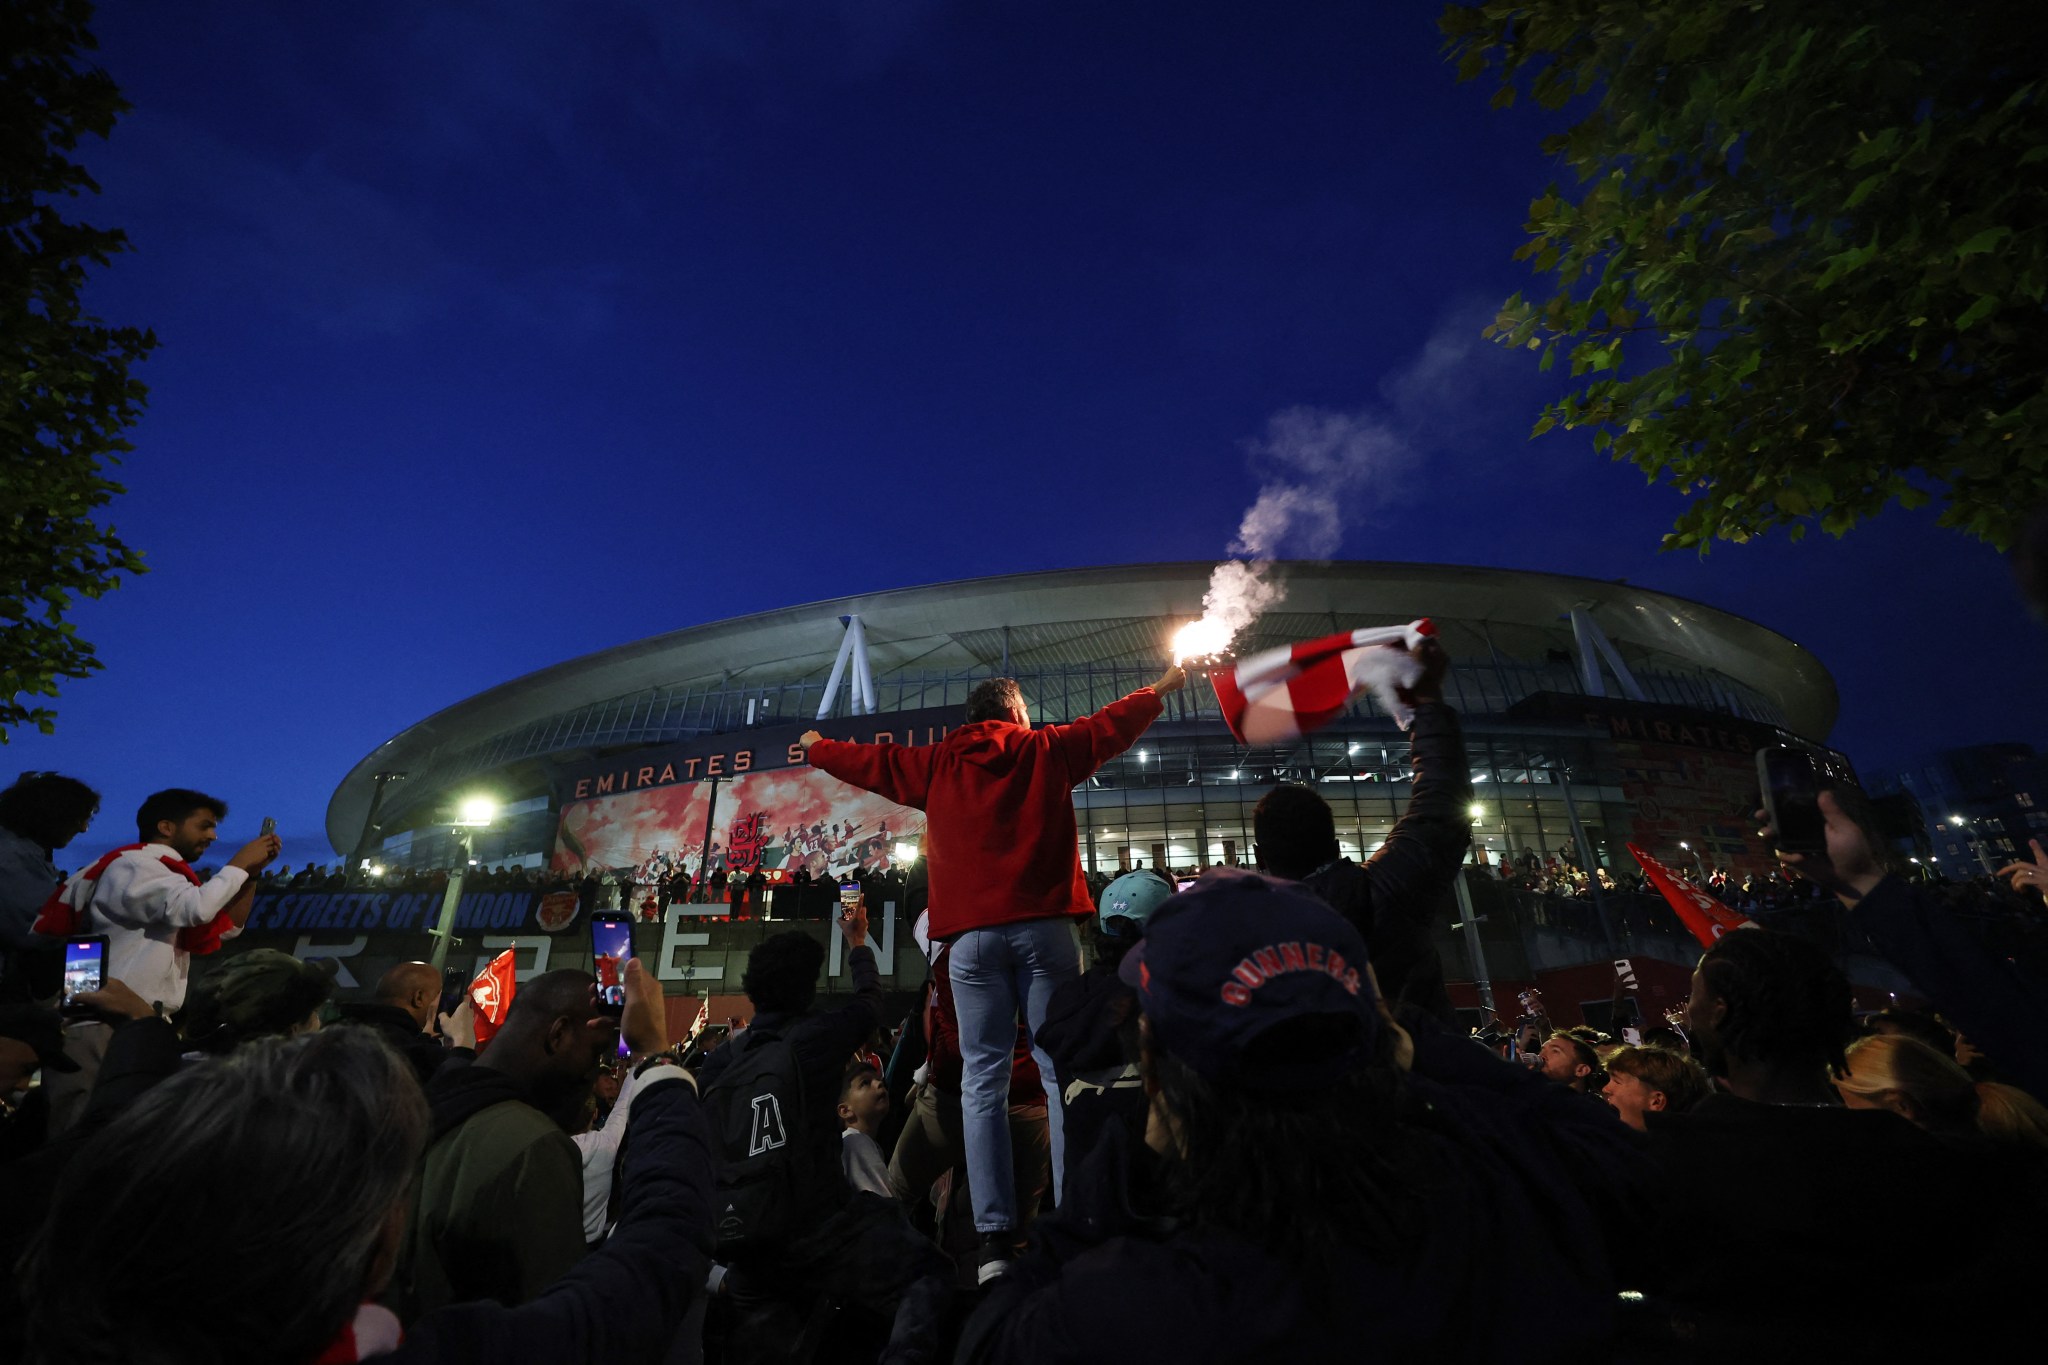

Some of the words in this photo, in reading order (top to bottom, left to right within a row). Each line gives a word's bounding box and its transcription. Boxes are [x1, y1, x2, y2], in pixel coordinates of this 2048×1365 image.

[574, 749, 752, 799] EMIRATES
[265, 892, 390, 929] STREETS
[386, 892, 429, 929] OF
[420, 891, 532, 931] LNDON
[1220, 942, 1362, 1008] GUNNERS
[748, 1092, 787, 1157] A
